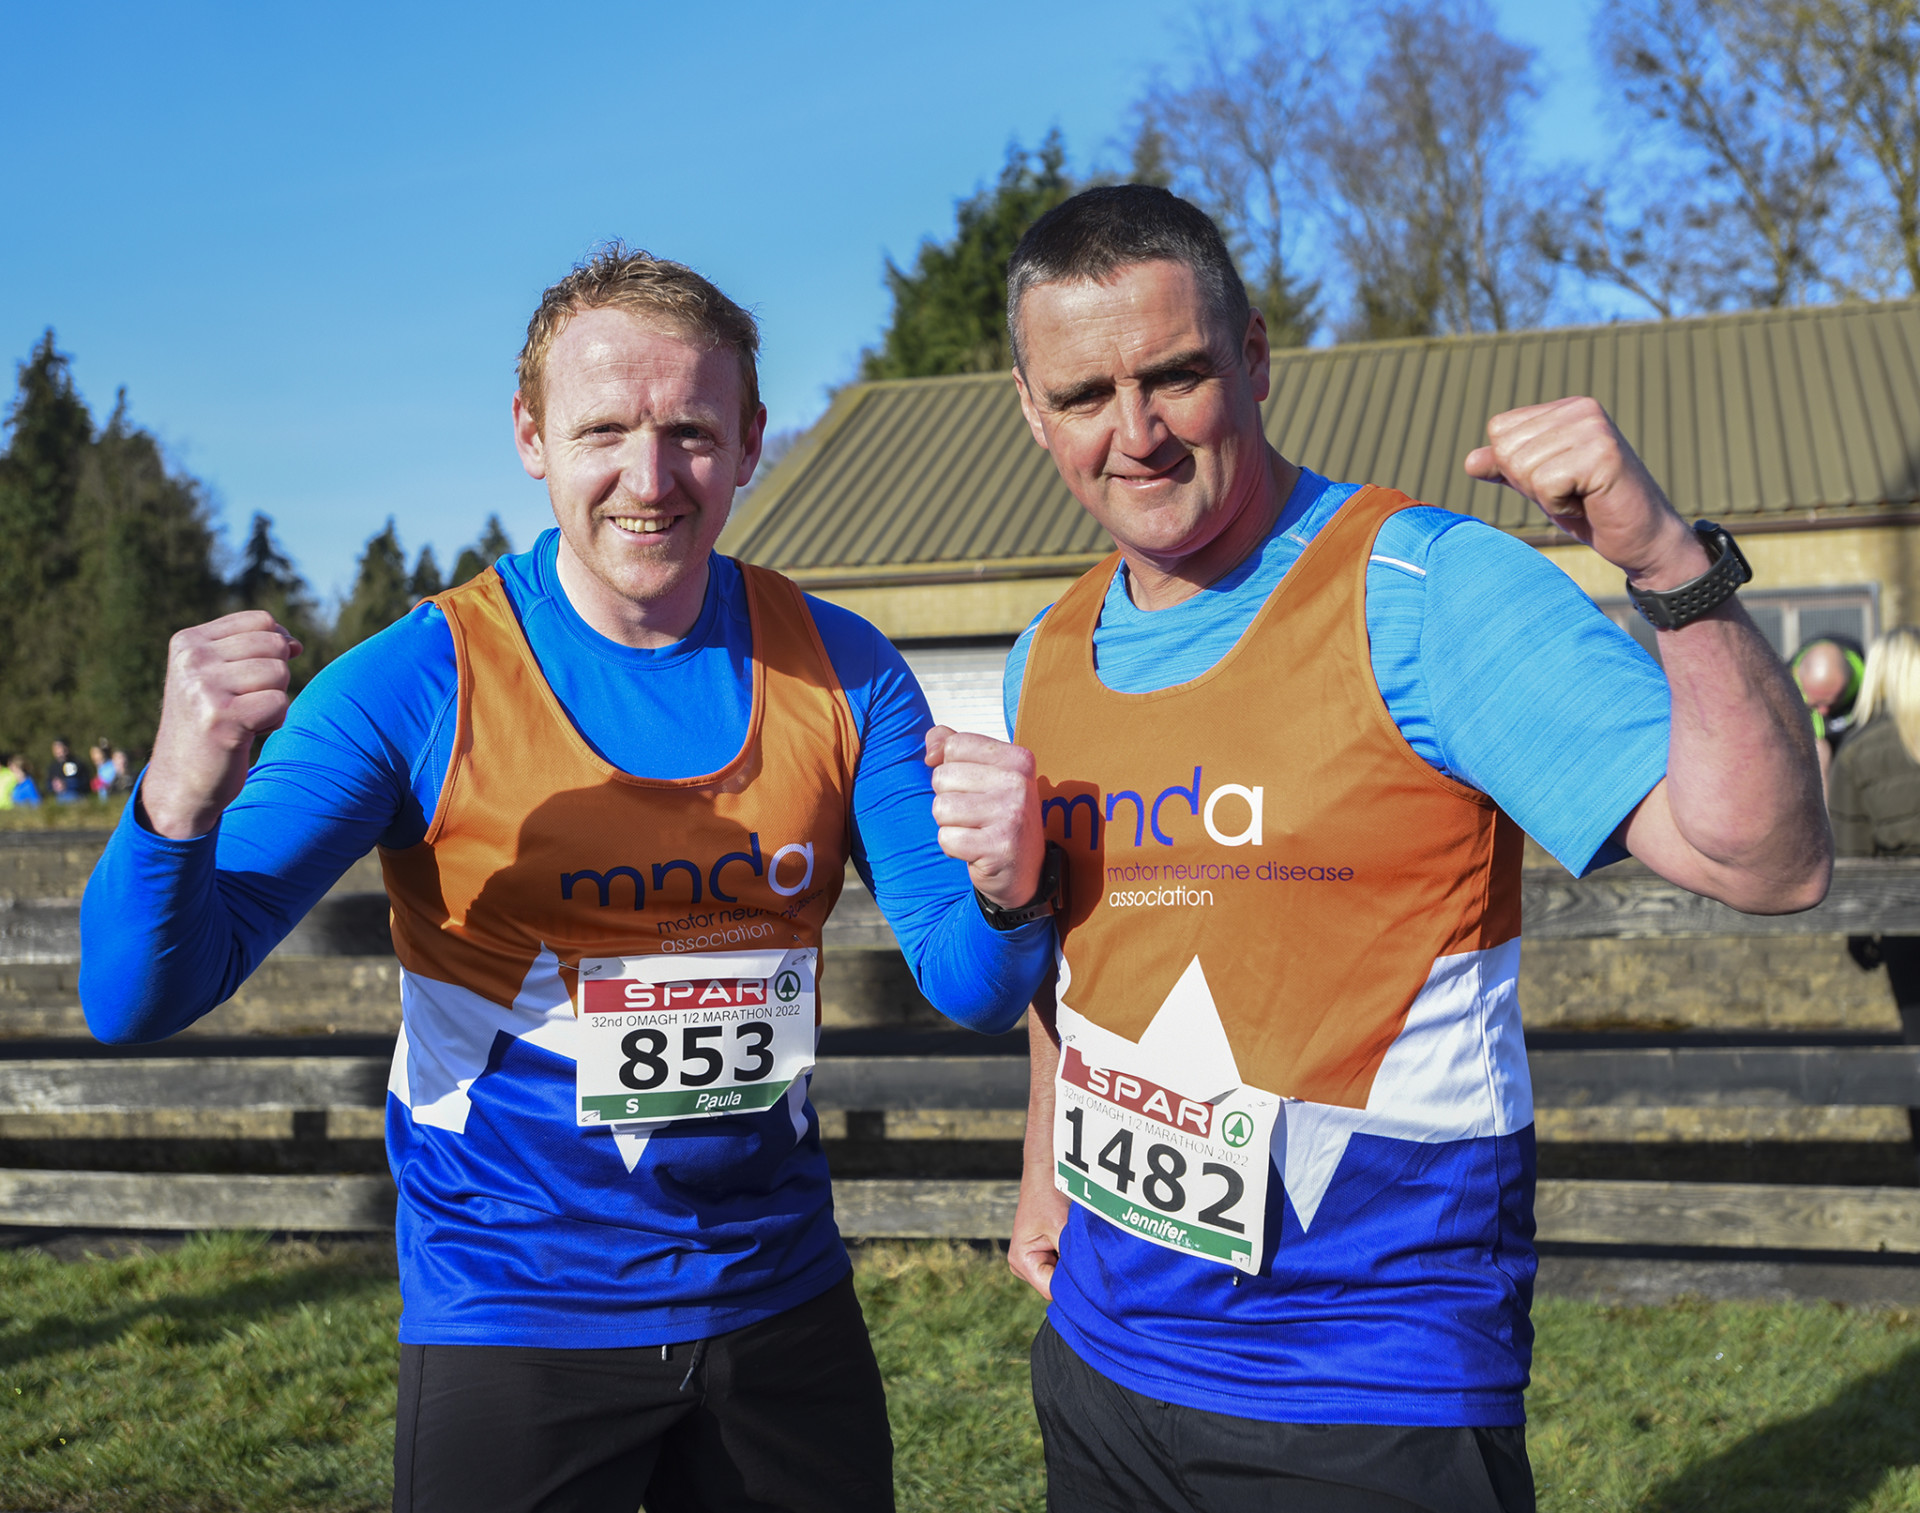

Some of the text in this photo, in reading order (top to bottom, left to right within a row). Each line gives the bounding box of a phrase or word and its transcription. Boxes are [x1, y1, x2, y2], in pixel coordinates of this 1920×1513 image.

[1041, 765, 1264, 850] mnda
[560, 832, 814, 911] mnda
[1107, 861, 1354, 882] motor neurone disease
[1109, 885, 1214, 907] association
[657, 913, 715, 935] motor
[661, 922, 775, 953] association
[624, 979, 764, 1008] SPAR
[591, 1004, 801, 1028] 32nd OMAGH 1/2 MARATHON 2022
[618, 1022, 775, 1090] 853
[625, 1098, 639, 1114] S
[695, 1091, 742, 1109] Paula
[1087, 1067, 1210, 1135] SPAR
[1063, 1085, 1250, 1168] 32nd OMAGH 1/2 MARATHON 2022
[1065, 1106, 1245, 1235] 1482
[1121, 1206, 1187, 1241] Jennifer
